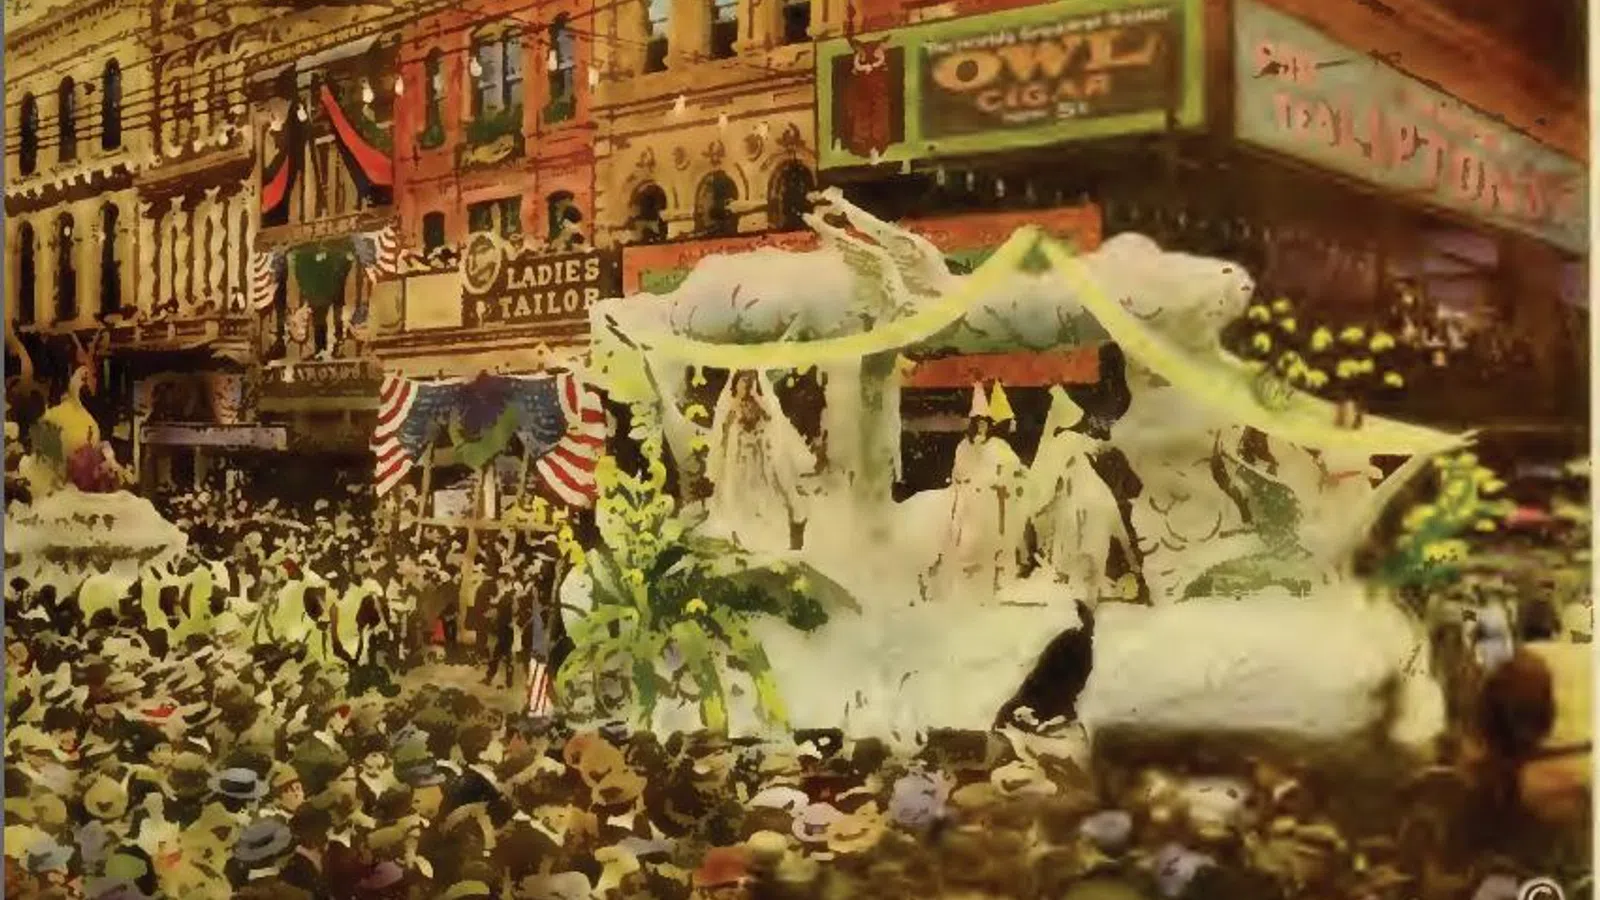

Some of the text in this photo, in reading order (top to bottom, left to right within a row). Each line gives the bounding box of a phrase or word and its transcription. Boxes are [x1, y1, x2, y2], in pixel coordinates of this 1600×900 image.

[932, 28, 1160, 92] OWL
[977, 73, 1111, 112] CIGAR
[507, 257, 600, 290] LADIES
[499, 288, 600, 319] TAILOR
